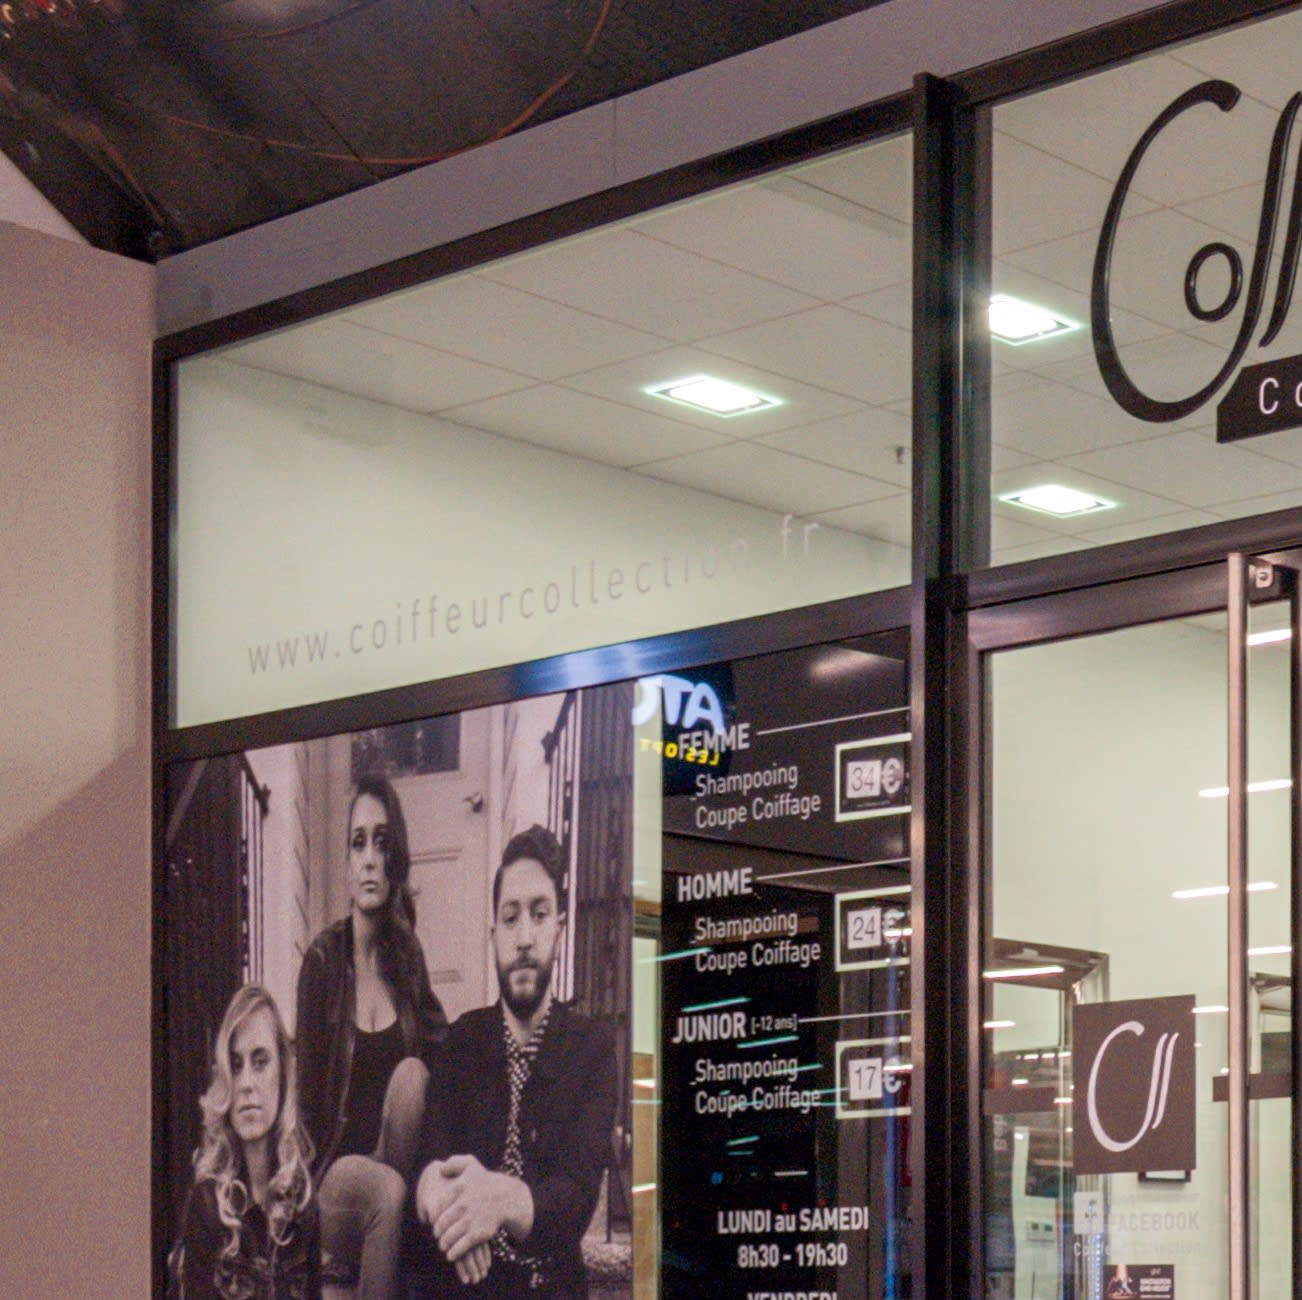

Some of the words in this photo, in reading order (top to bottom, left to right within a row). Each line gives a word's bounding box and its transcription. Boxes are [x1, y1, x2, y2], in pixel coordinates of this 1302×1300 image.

[248, 514, 819, 675] www.coiffeurcollectionfr
[678, 723, 750, 760] FEMME
[695, 762, 798, 797] Shampooing
[696, 806, 747, 830] Coupe
[752, 793, 821, 820] Coiffage
[678, 867, 753, 902] HOMME
[695, 909, 798, 941] Shampooing
[696, 951, 747, 975] Coupe
[752, 940, 821, 968] Coiffage
[671, 1011, 746, 1044] JUNIOR
[695, 1054, 798, 1085] Shampooing
[696, 1091, 747, 1118] Coupe
[752, 1086, 821, 1114] Coiffage
[717, 1210, 771, 1234] LUNDI
[775, 1214, 796, 1232] au
[800, 1206, 869, 1231] SAMEDI
[737, 1244, 779, 1268] 8h30
[796, 1243, 848, 1267] 19h30
